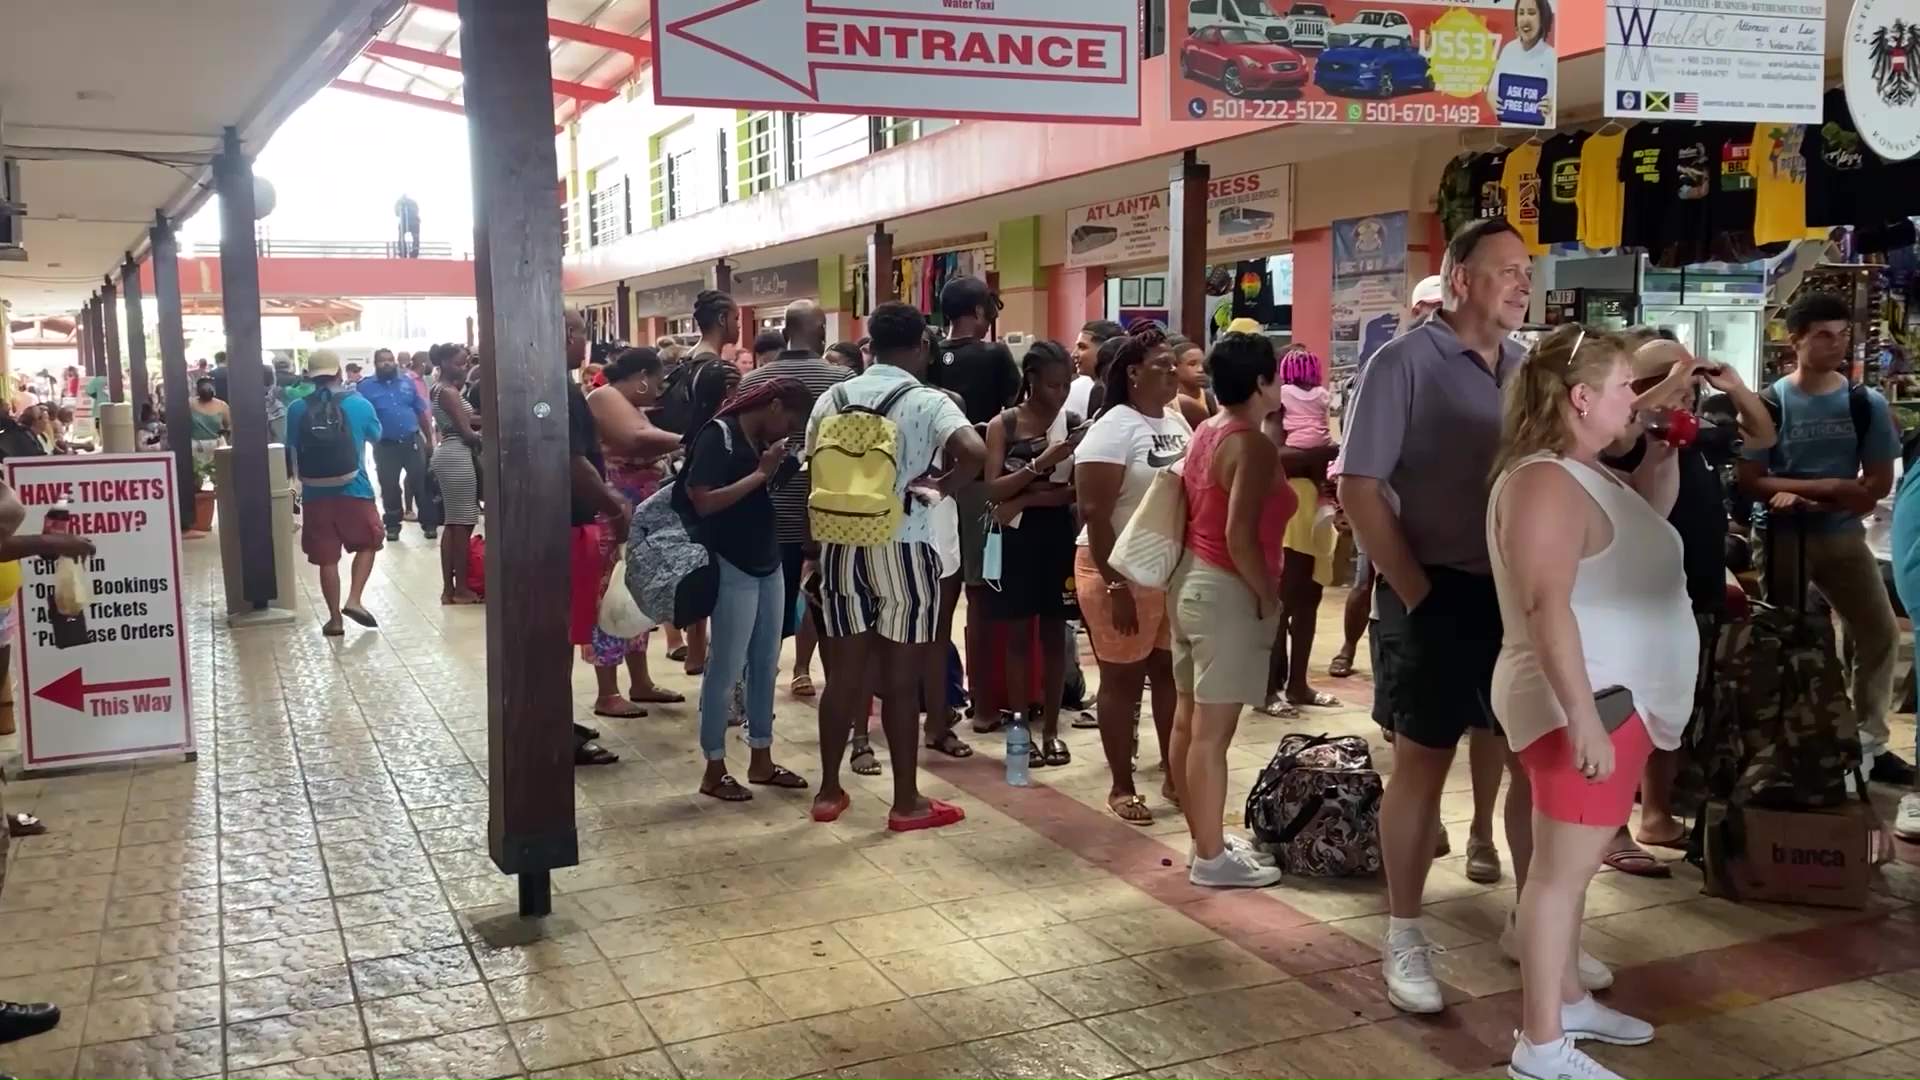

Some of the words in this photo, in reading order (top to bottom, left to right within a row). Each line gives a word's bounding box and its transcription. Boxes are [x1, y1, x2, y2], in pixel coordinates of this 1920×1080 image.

[806, 22, 1106, 69] ENTRANCE
[1418, 28, 1503, 62] US$37
[1507, 85, 1522, 98] ASK
[1523, 87, 1538, 99] FOR
[1213, 99, 1338, 120] 501-222-5122
[1366, 102, 1480, 124] 501-670-1493
[1086, 194, 1161, 222] ATLANTA
[1208, 174, 1260, 199] RESS
[1790, 423, 1856, 439] OUTREAC
[1151, 434, 1185, 452] NIKE
[20, 481, 73, 505] HAVE
[79, 478, 165, 502] TICKETS
[68, 510, 148, 536] READY?
[93, 575, 169, 596] Bookings
[89, 601, 148, 619] Tickets
[121, 622, 175, 642] Orders
[90, 696, 129, 717] This
[133, 694, 172, 715] Way
[1771, 842, 1846, 867] banca
